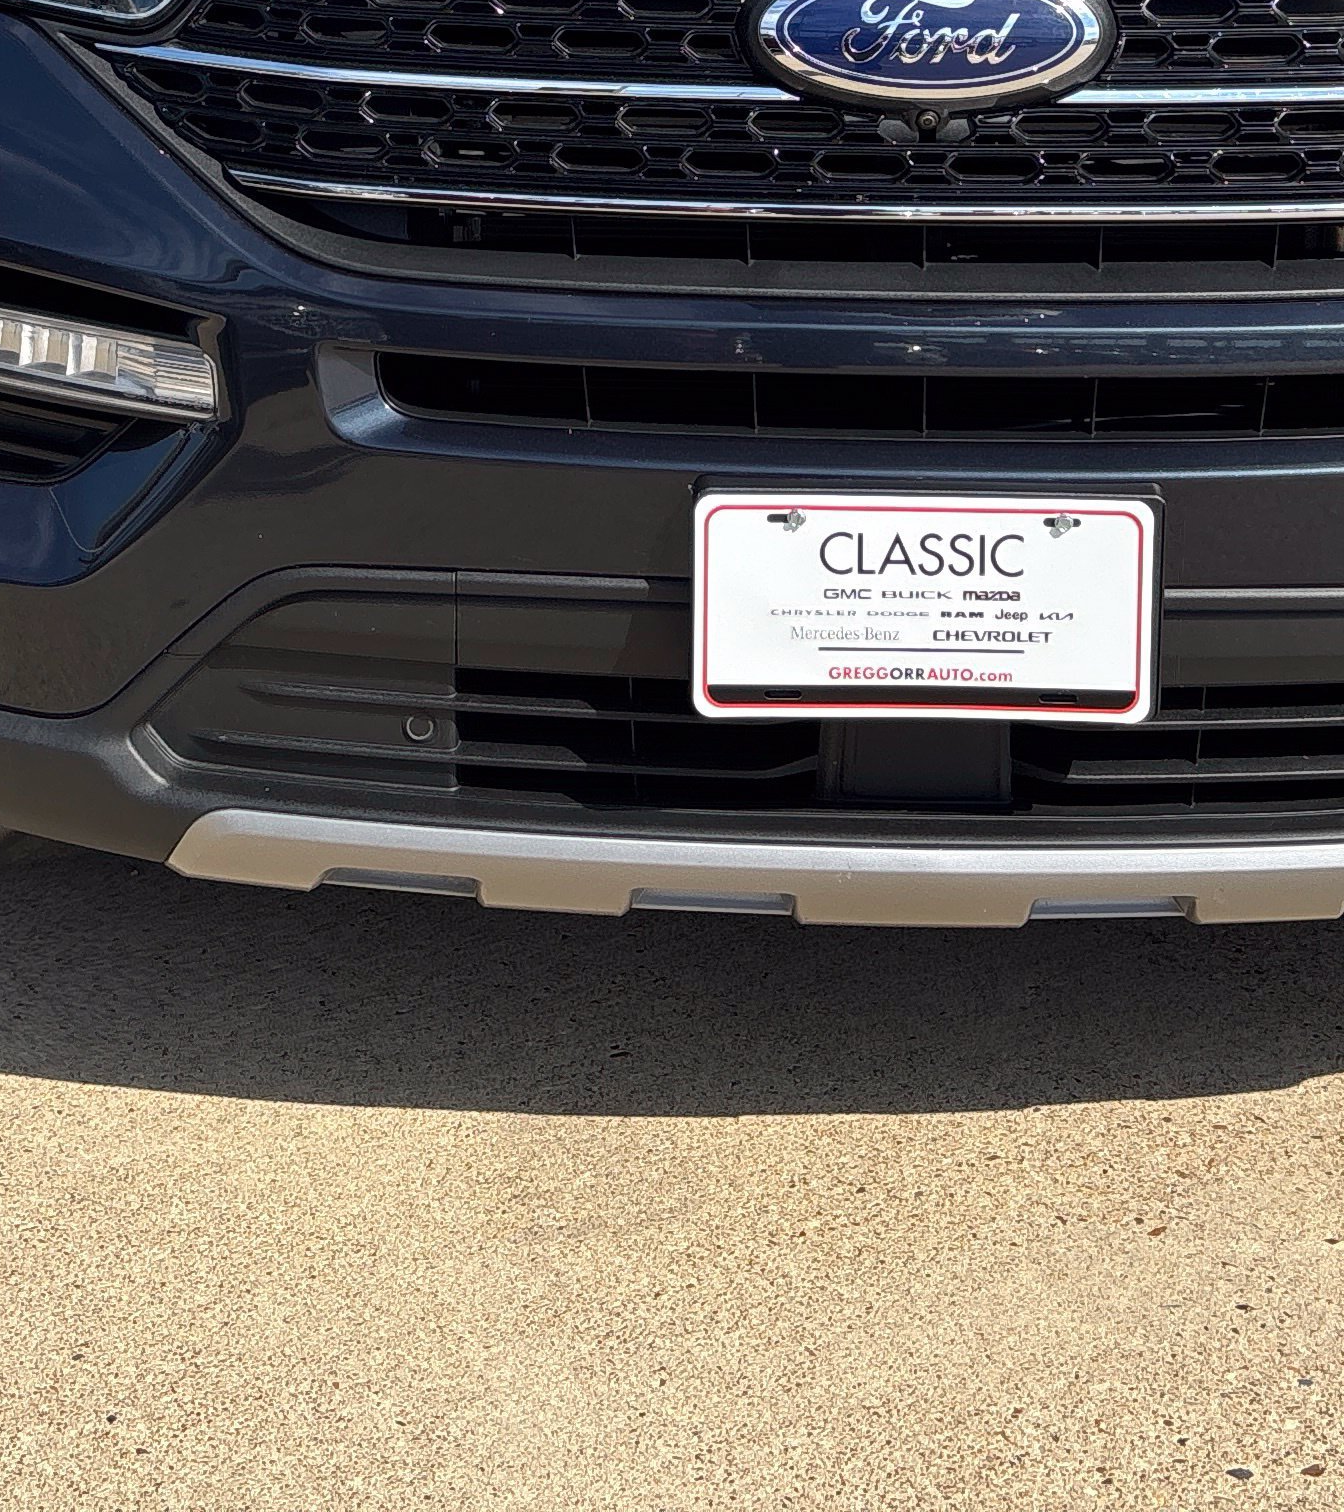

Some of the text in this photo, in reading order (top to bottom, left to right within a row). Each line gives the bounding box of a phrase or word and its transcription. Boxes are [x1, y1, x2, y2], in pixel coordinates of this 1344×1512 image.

[819, 532, 1025, 578] CLASSIC
[823, 588, 873, 600] GMC
[881, 590, 953, 600] BUICK
[770, 608, 857, 617] CHRYSLER
[866, 609, 930, 617] DODGE
[940, 610, 985, 619] RAM
[994, 608, 1029, 623] Jeep
[790, 625, 1054, 644] Mercedes-Benz CHEVROLET
[828, 665, 1014, 683] GREGGORRAUTO.com
